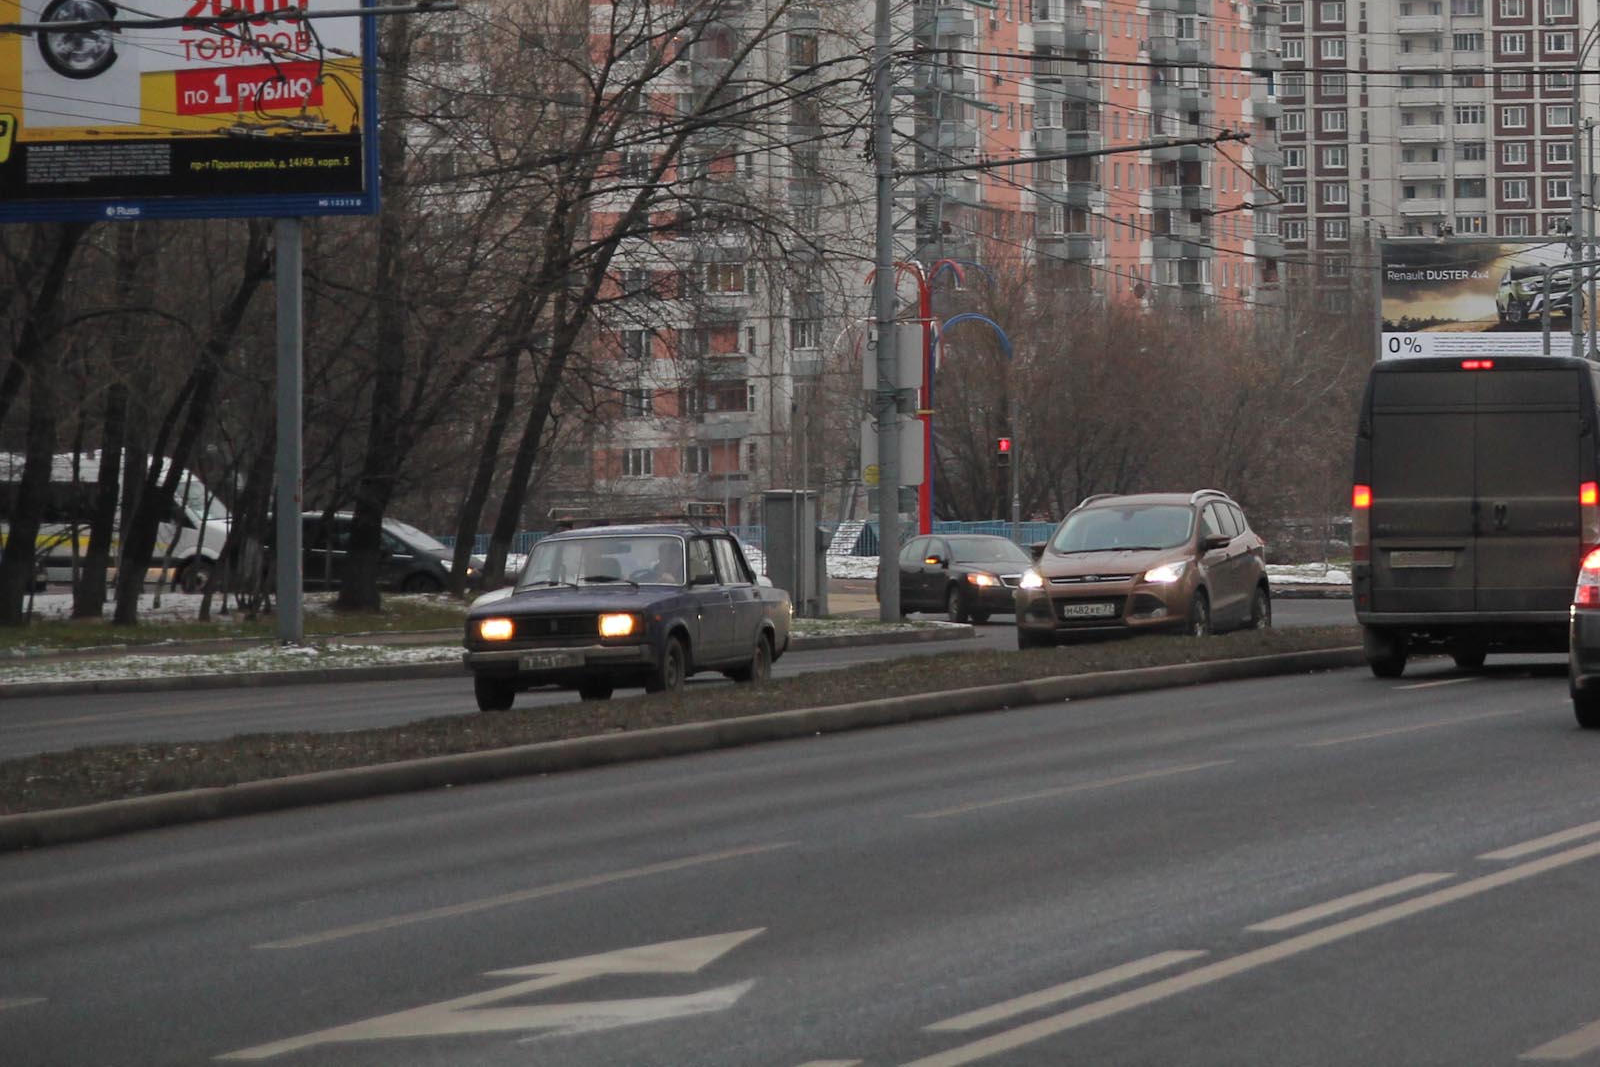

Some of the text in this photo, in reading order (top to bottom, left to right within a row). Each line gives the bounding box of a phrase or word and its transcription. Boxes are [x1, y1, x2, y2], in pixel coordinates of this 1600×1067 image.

[179, 31, 311, 61] ТОВАРОВ
[214, 74, 232, 104] 1
[238, 78, 312, 101] РУБЛЮ
[343, 156, 350, 166] 3
[1387, 269, 1490, 281] Renault DUSTER 4x4
[1388, 336, 1401, 354] 0
